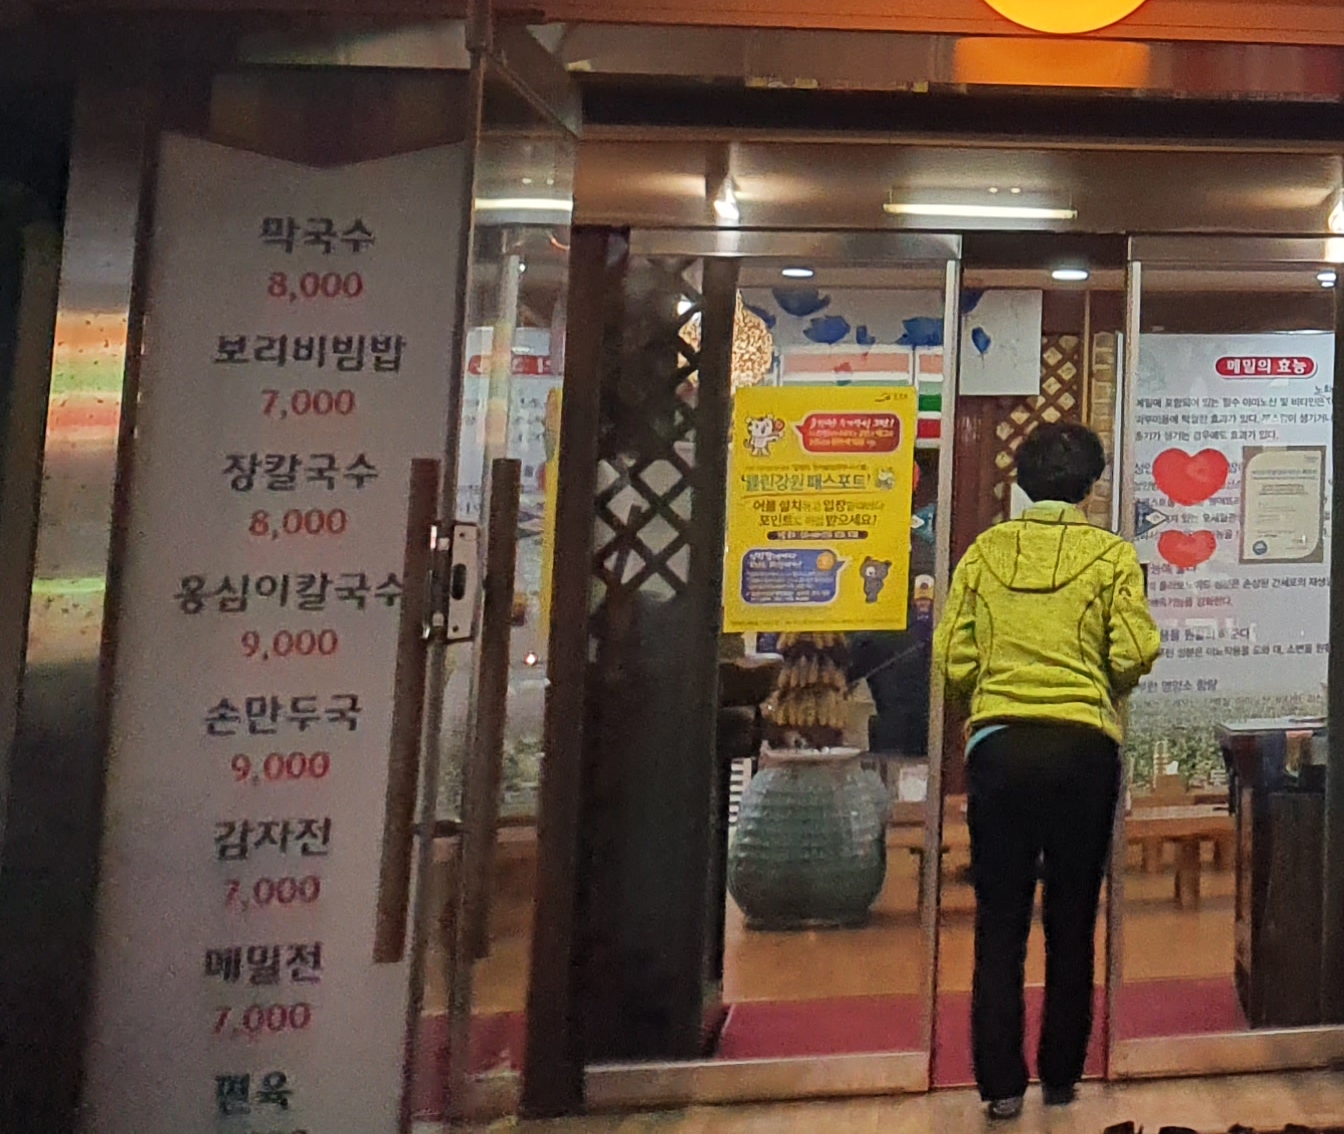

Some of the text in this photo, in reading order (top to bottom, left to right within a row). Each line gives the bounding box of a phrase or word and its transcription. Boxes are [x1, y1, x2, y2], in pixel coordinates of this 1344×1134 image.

[260, 217, 376, 254] 막국수
[267, 271, 364, 303] 8,000
[214, 333, 407, 373] 보리비빔밥
[1226, 358, 1308, 375] 메밀의 효능
[261, 388, 357, 420] 7,000
[223, 453, 379, 492] 장칼국수
[249, 508, 348, 540] 8,000
[241, 628, 339, 660] 9,000
[205, 693, 362, 737] 손만두국
[231, 750, 331, 785] 9,000
[214, 816, 332, 862] 감자전
[224, 875, 321, 911] 7,000
[205, 940, 324, 986] 메밀전
[212, 1001, 312, 1037] 7,000
[214, 1070, 293, 1116] 편육
